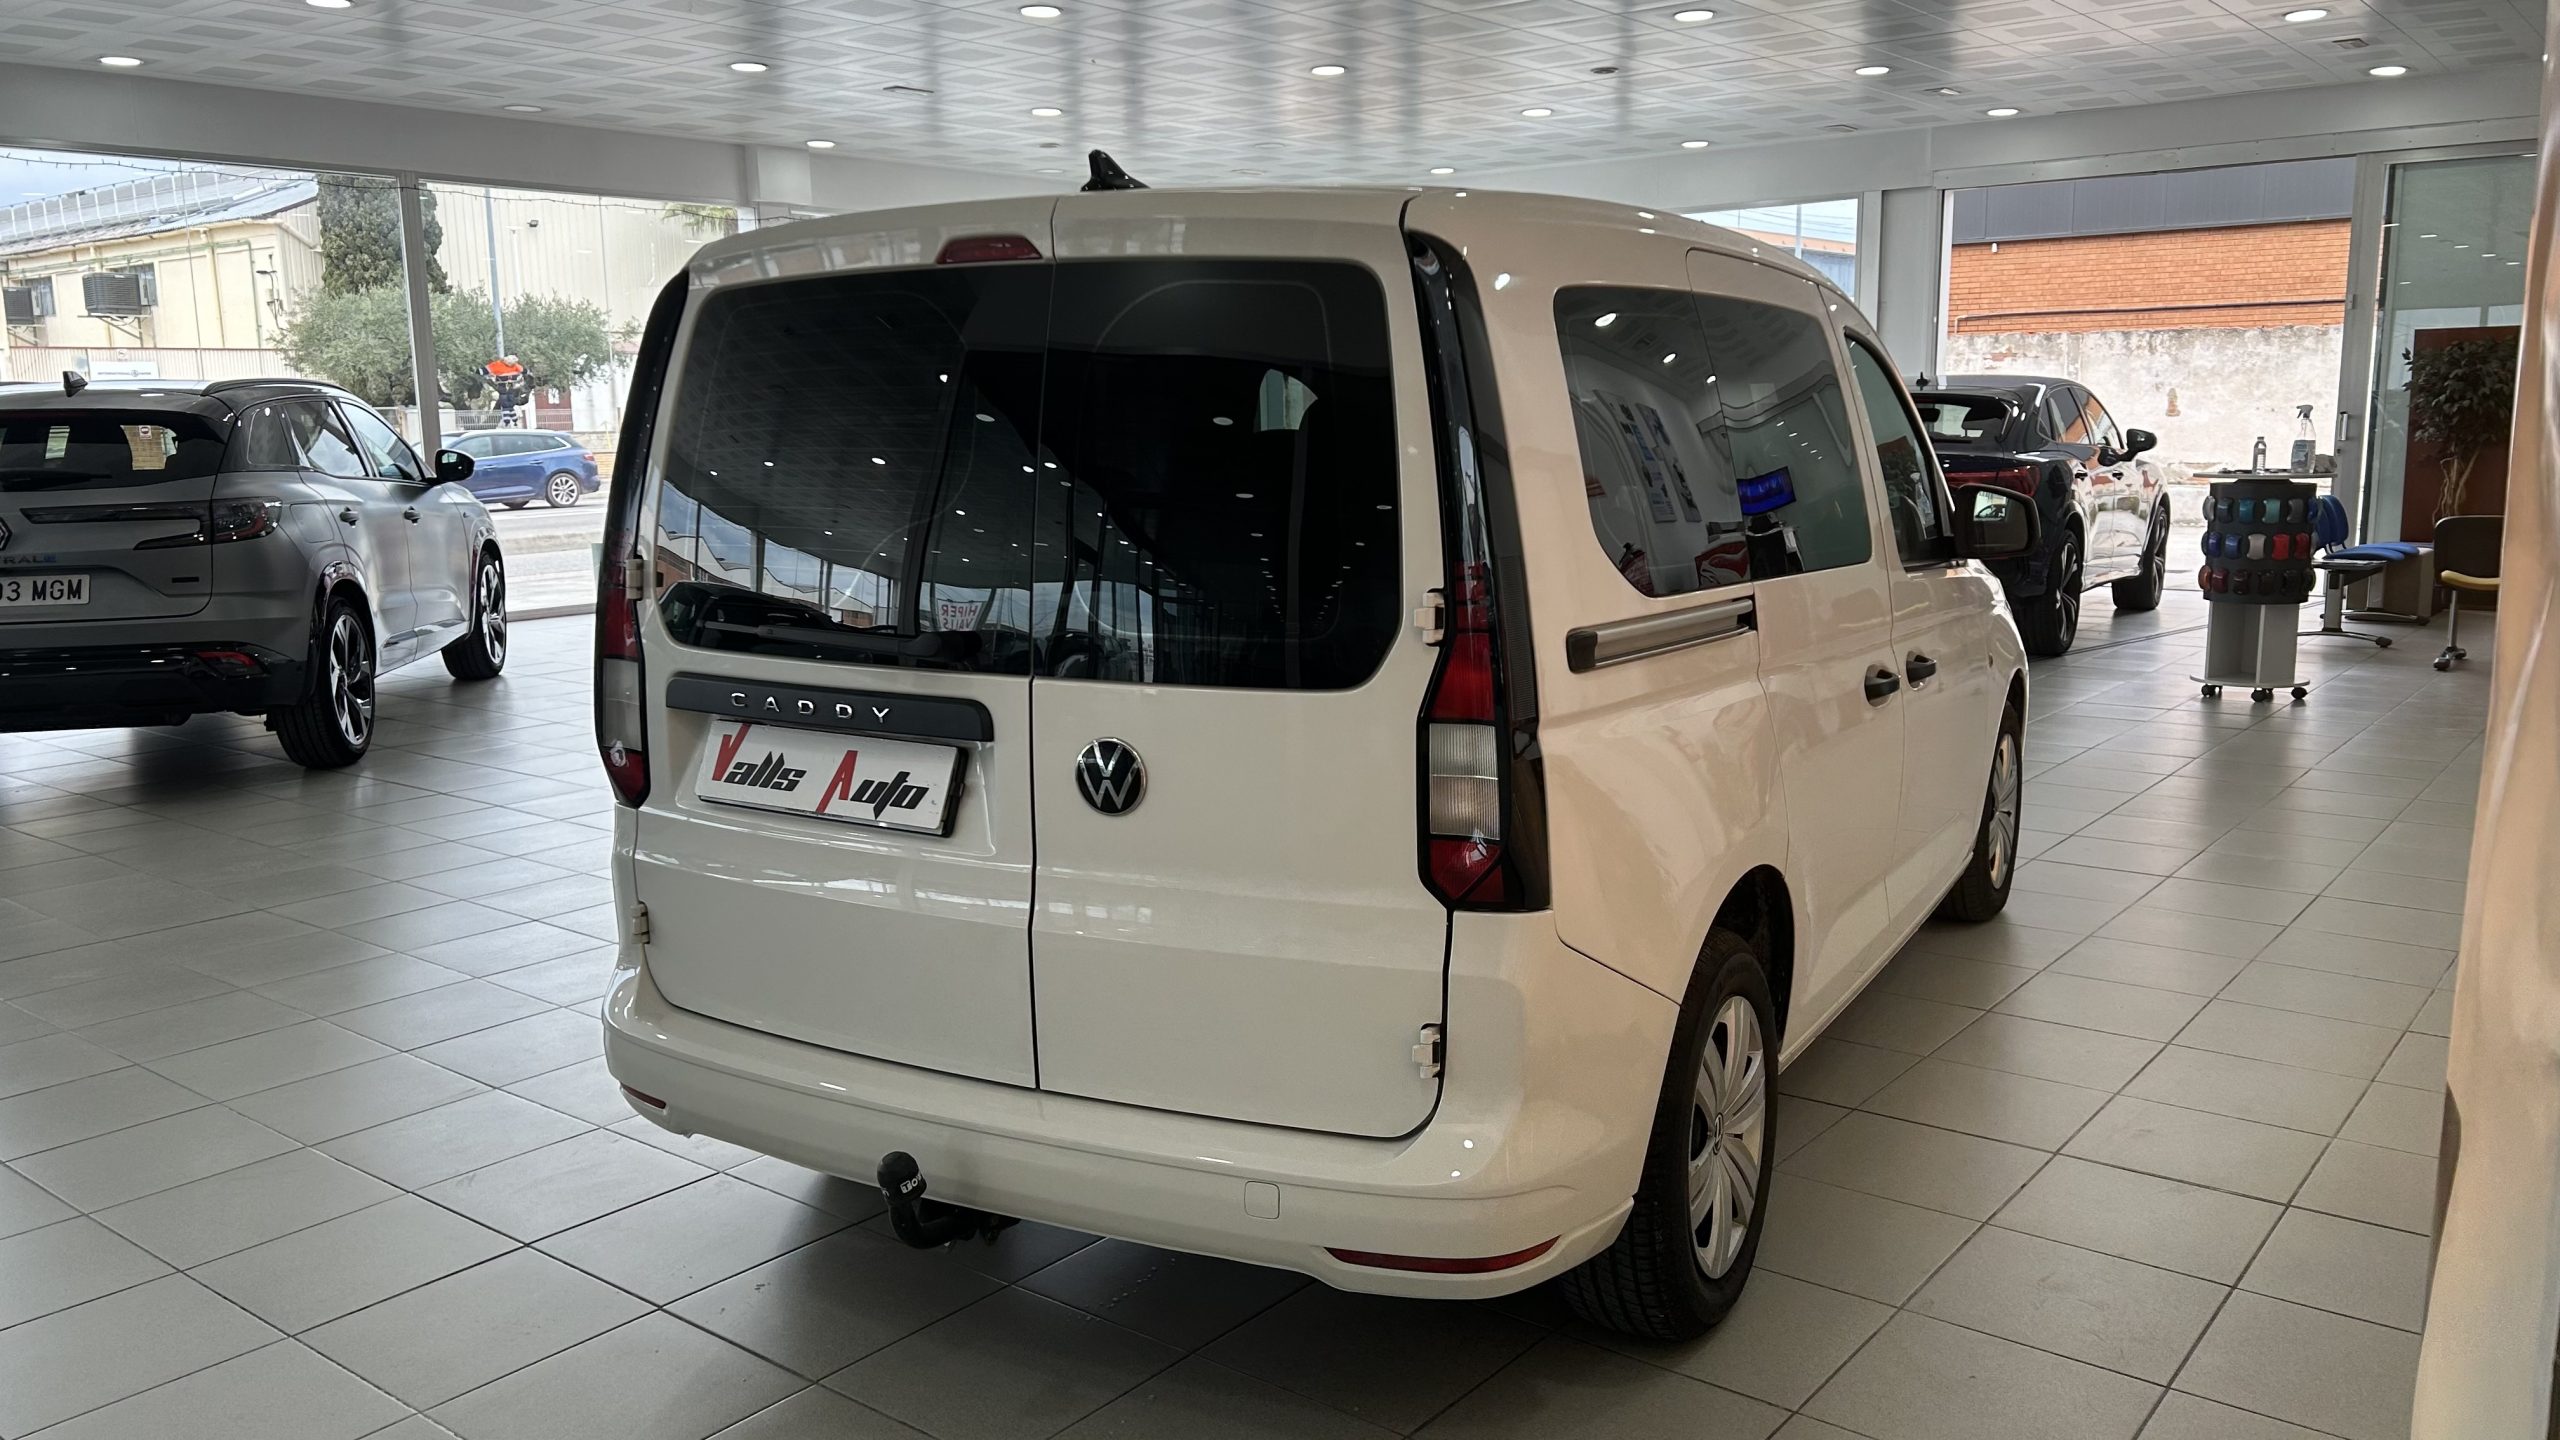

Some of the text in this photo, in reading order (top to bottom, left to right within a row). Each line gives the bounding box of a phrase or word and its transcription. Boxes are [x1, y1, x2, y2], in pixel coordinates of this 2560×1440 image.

[0, 579, 82, 601] 3 MGM
[731, 692, 890, 723] CADDY
[712, 723, 929, 819] Valls Auto
